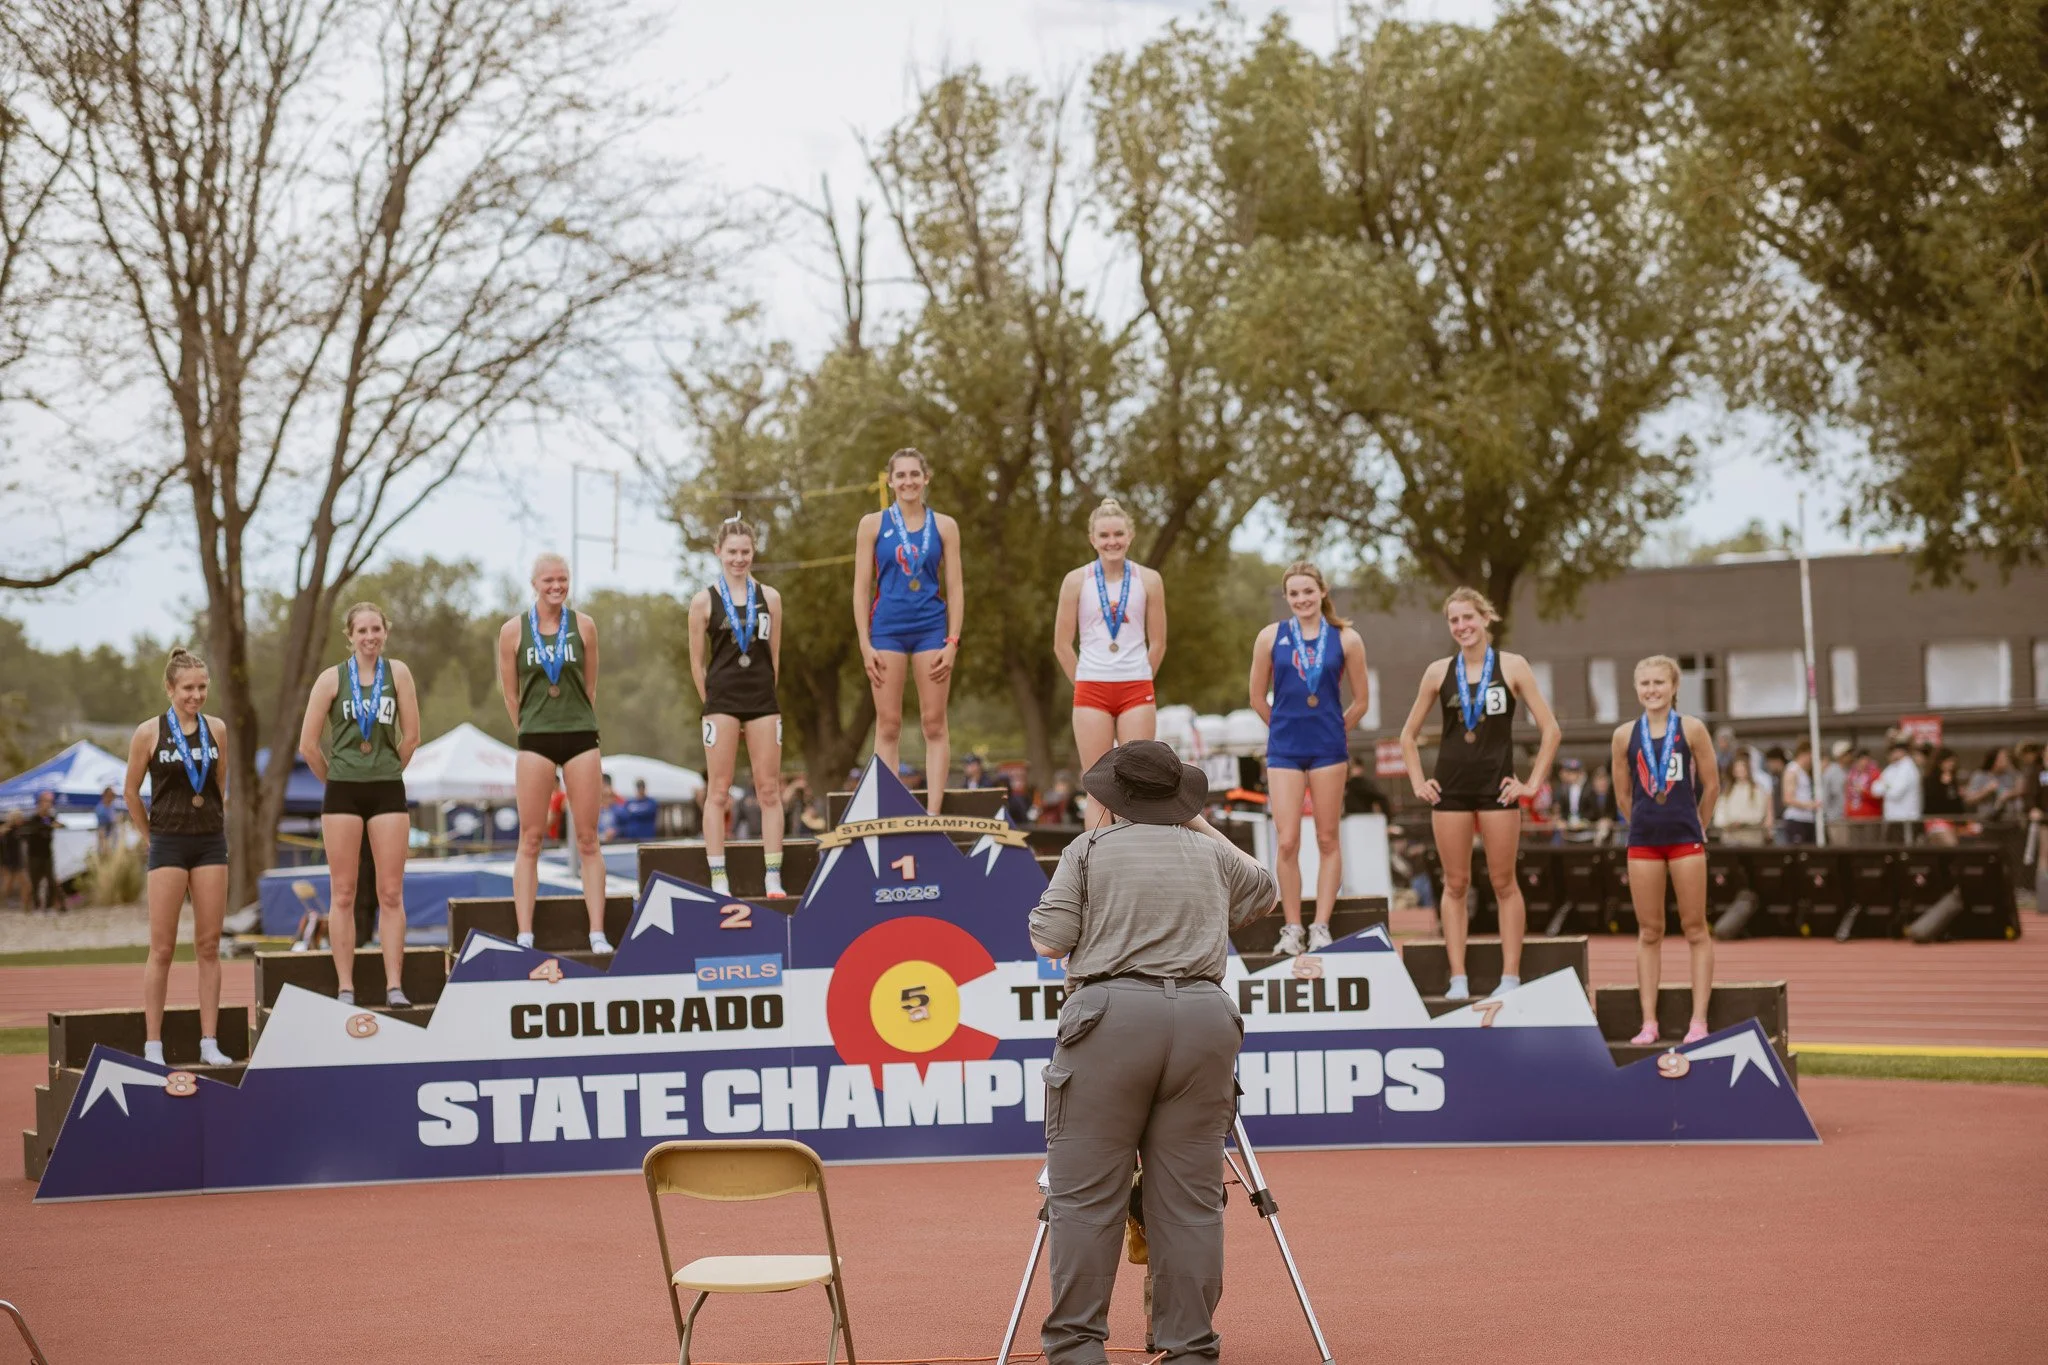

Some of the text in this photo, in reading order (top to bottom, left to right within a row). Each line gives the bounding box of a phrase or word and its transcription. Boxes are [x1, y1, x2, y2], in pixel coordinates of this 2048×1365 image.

[526, 643, 577, 667] FSIL
[159, 746, 219, 764] RAES
[841, 819, 1002, 836] STATE CHAMPION
[891, 855, 915, 880] 1
[875, 885, 940, 902] 2025
[719, 904, 753, 929] 2
[529, 958, 563, 983] 4
[697, 963, 778, 982] GIRLS
[1291, 956, 1323, 979] 5
[510, 994, 784, 1039] COLORADO
[1238, 977, 1370, 1014] FIELD
[901, 985, 930, 1010] 5
[345, 1013, 379, 1039] 6
[1472, 1001, 1503, 1028] 7
[1657, 1052, 1690, 1078] 9
[164, 1071, 198, 1097] 8
[417, 1072, 689, 1147] STATE
